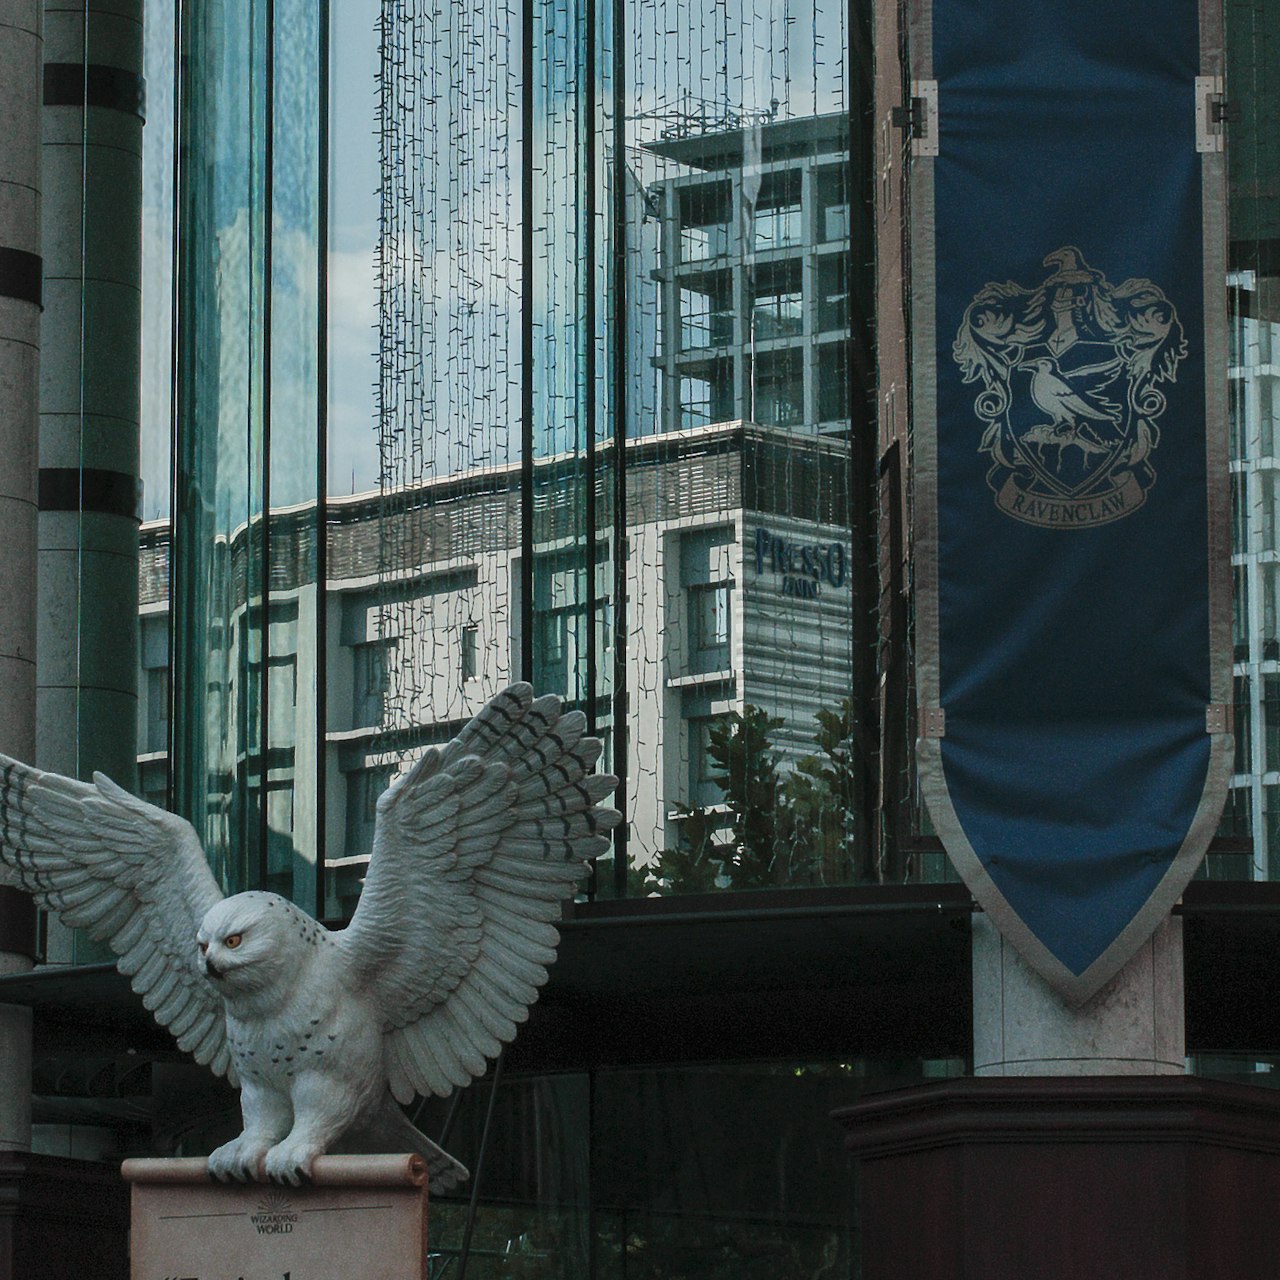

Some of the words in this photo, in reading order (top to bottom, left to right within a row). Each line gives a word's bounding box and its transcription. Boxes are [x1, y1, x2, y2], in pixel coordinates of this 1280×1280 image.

[1012, 491, 1126, 523] RAVENCLAW
[250, 1213, 298, 1225] WIZARDING
[256, 1223, 293, 1234] WORLD
